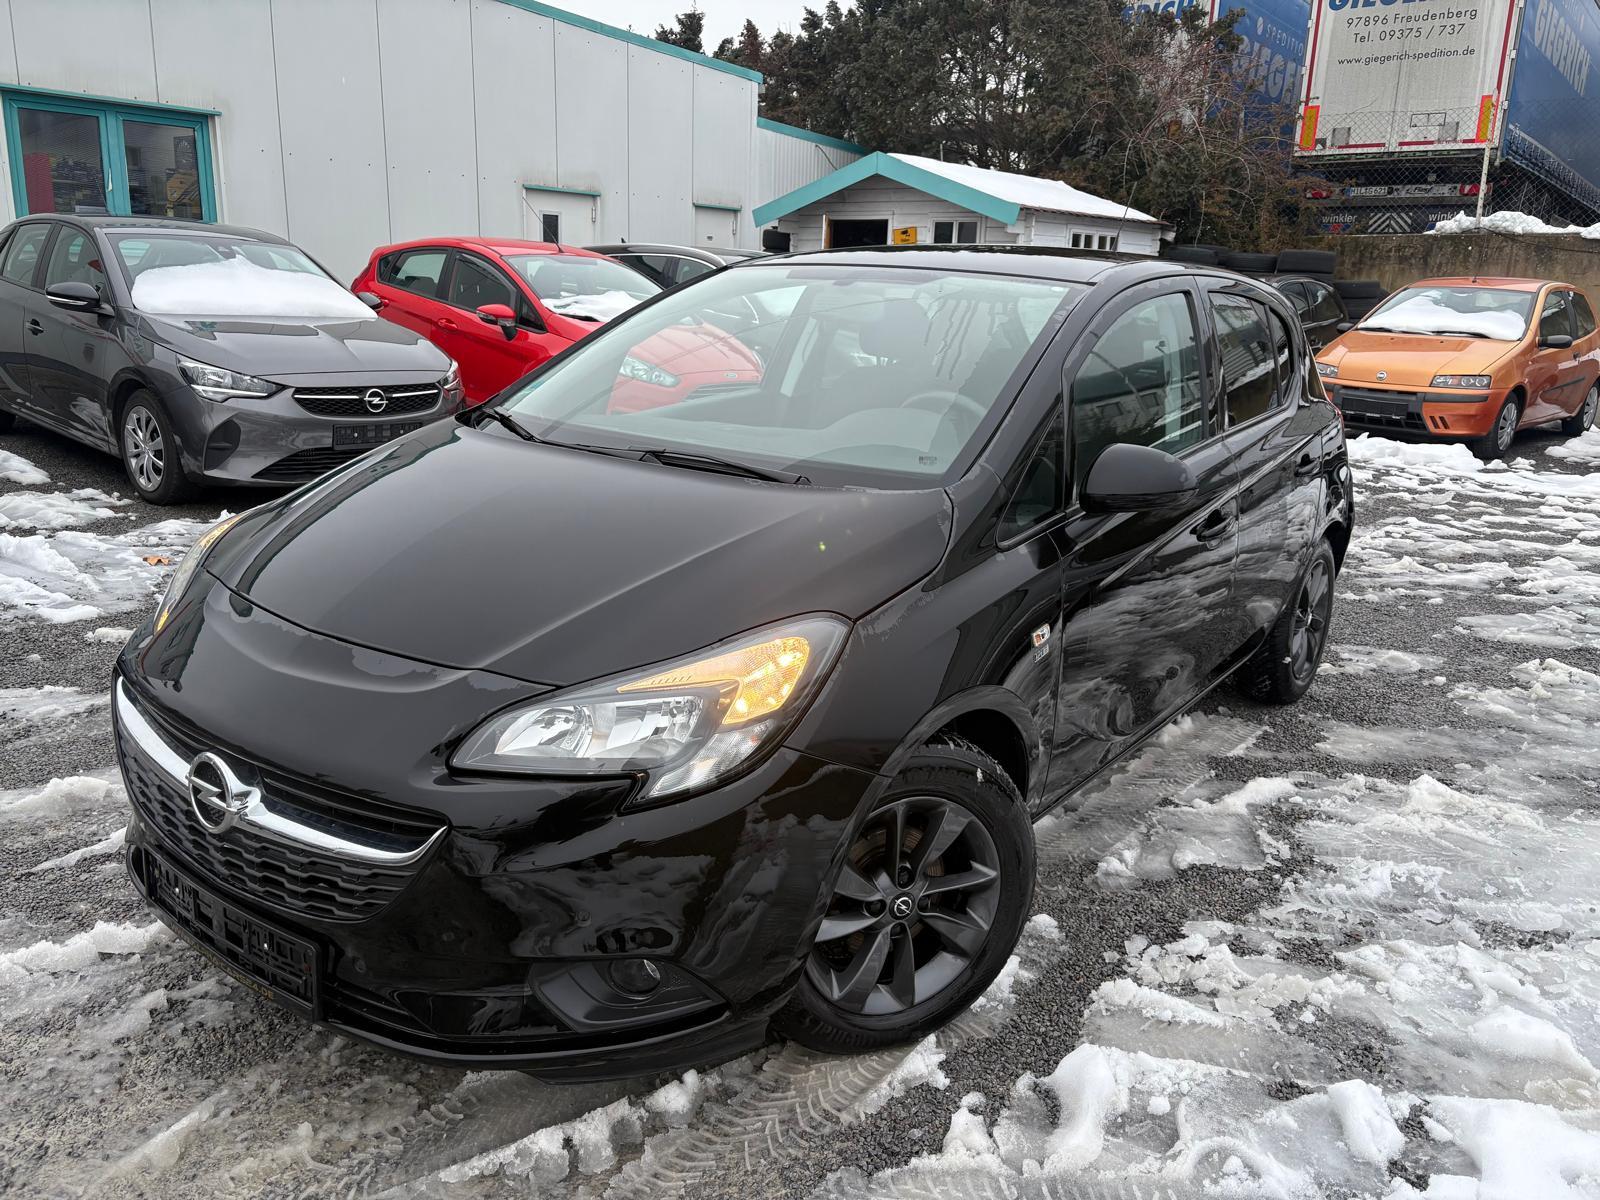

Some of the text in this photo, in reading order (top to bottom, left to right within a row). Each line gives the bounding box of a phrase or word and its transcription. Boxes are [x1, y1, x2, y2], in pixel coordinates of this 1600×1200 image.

[1346, 8, 1478, 29] 97896 Freudenberg
[1353, 23, 1466, 44] Tel. 09375 / 737
[1337, 46, 1476, 66] www.giegerich-spedition.de
[1322, 213, 1358, 223] winkler
